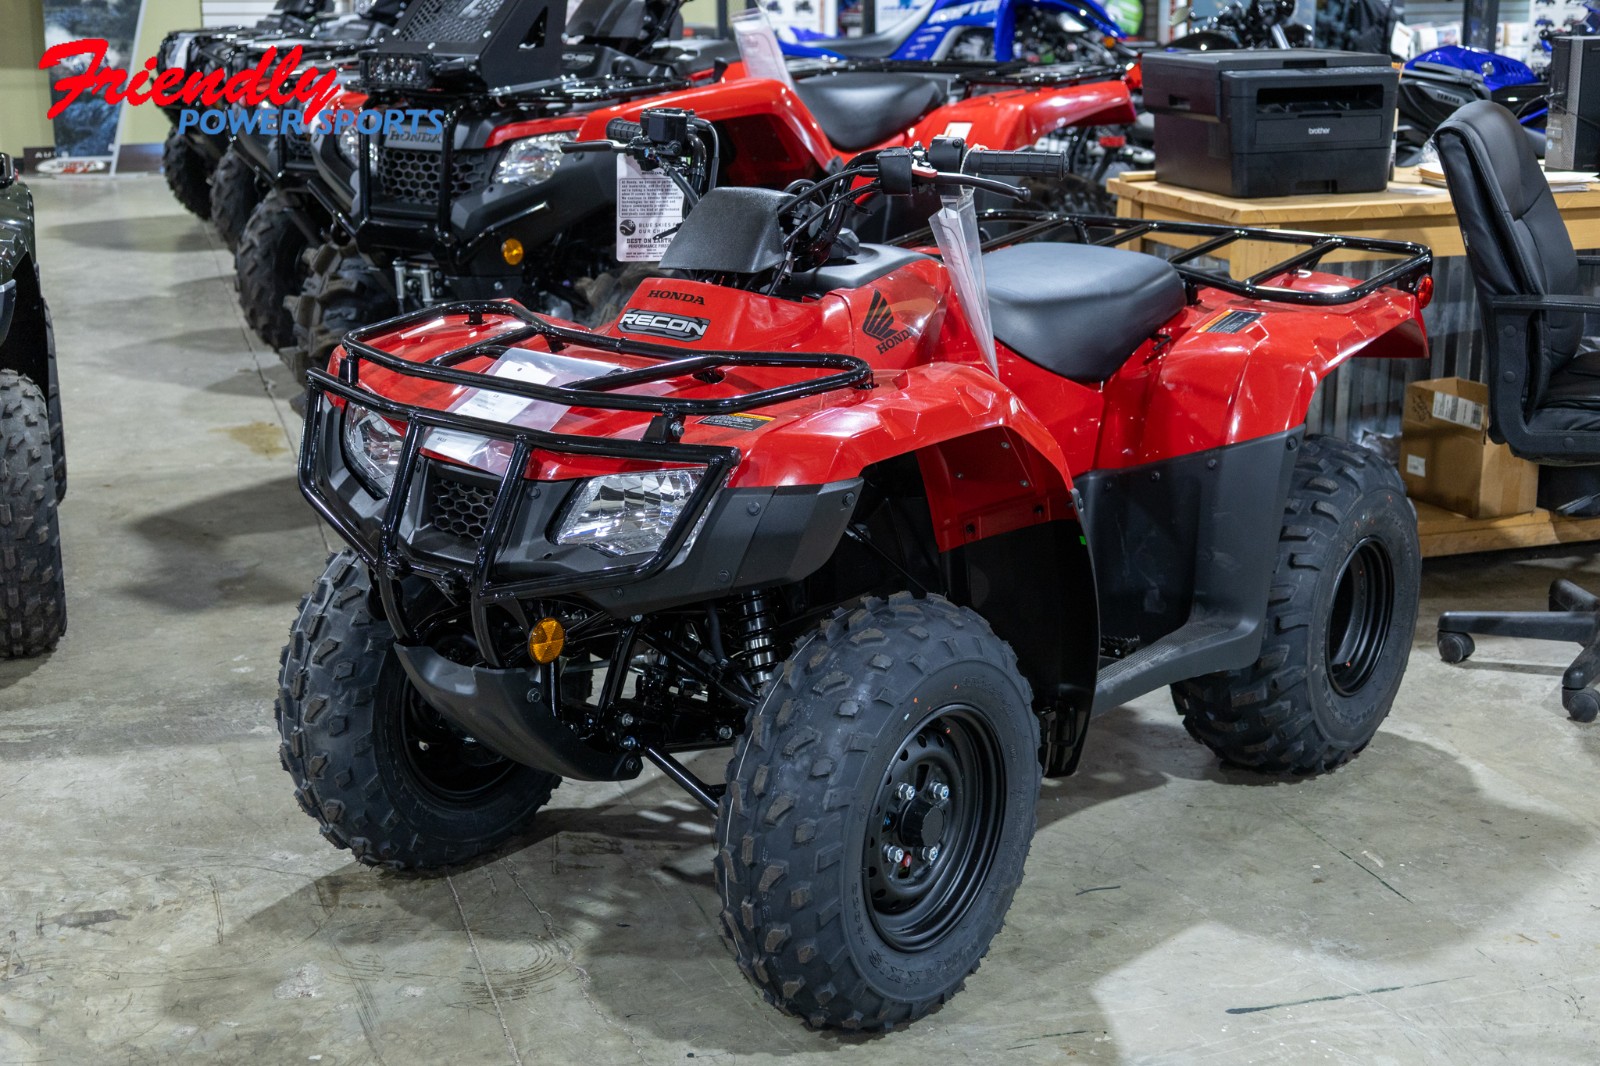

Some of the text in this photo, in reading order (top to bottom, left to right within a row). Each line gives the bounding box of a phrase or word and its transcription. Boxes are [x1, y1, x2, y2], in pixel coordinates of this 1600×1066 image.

[1308, 127, 1331, 135] brother
[647, 289, 705, 305] HONDA
[619, 313, 708, 336] RECON
